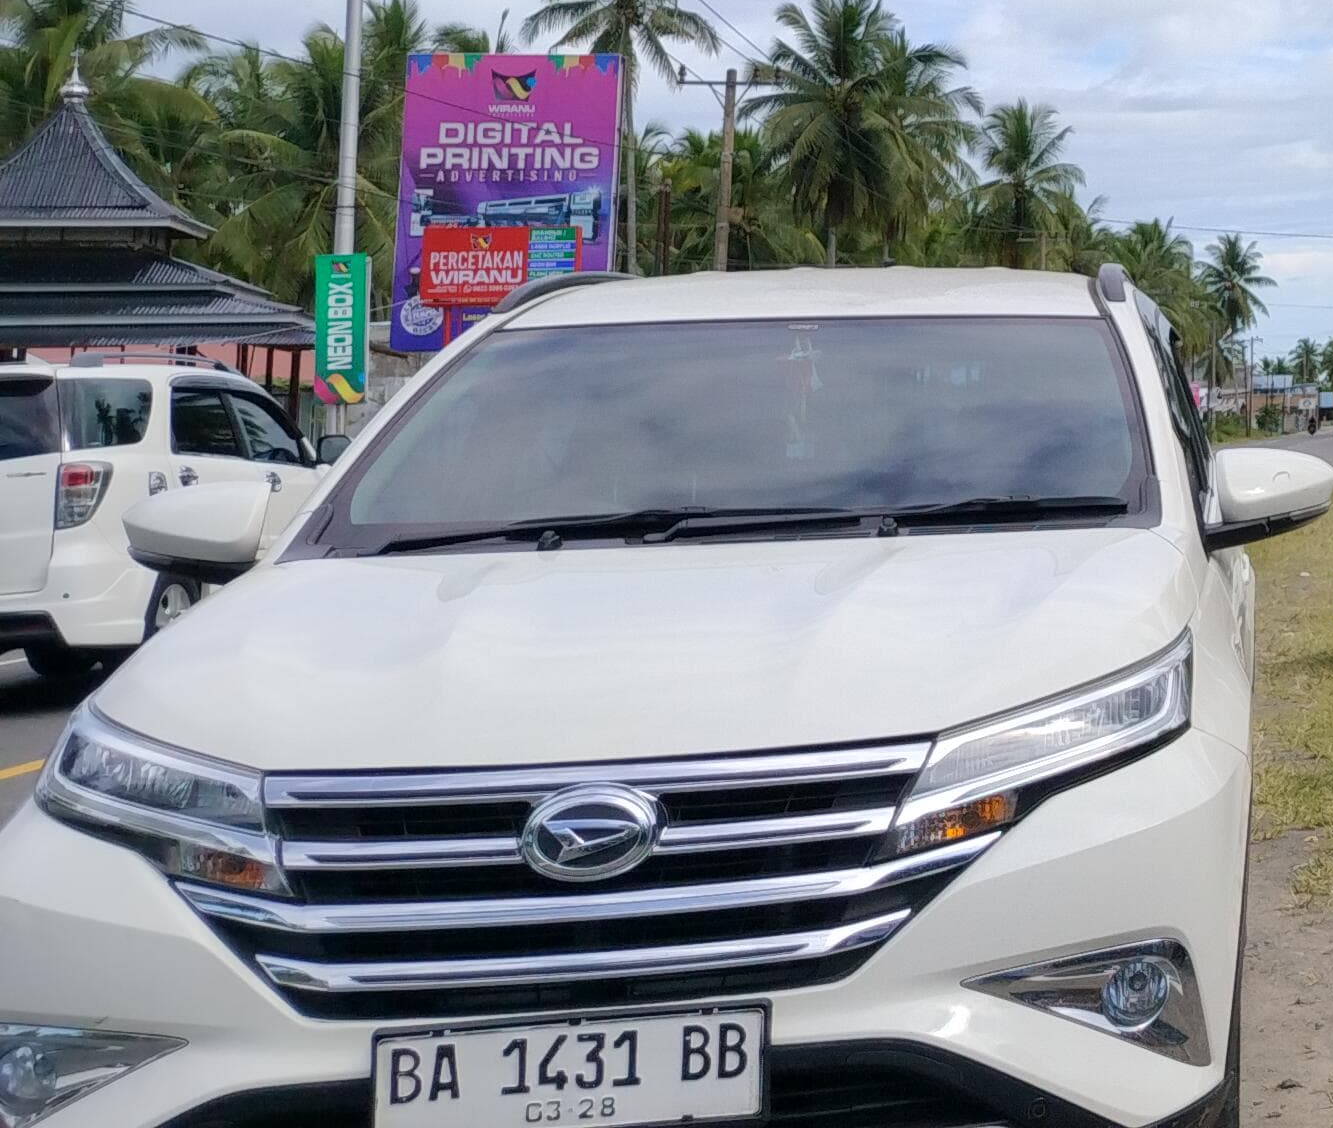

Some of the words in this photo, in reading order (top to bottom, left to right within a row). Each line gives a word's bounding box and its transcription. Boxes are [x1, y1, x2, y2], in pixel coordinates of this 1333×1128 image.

[488, 104, 536, 113] WIRANU
[438, 122, 584, 145] DIGITAL
[419, 147, 600, 170] PRINTING
[429, 250, 523, 270] PERCETAKAN
[430, 269, 522, 284] WIRANU
[327, 282, 354, 319] BOX
[327, 320, 353, 371] NEON
[390, 1043, 460, 1105] BA
[501, 1030, 641, 1095] 1431
[681, 1022, 748, 1081] BB
